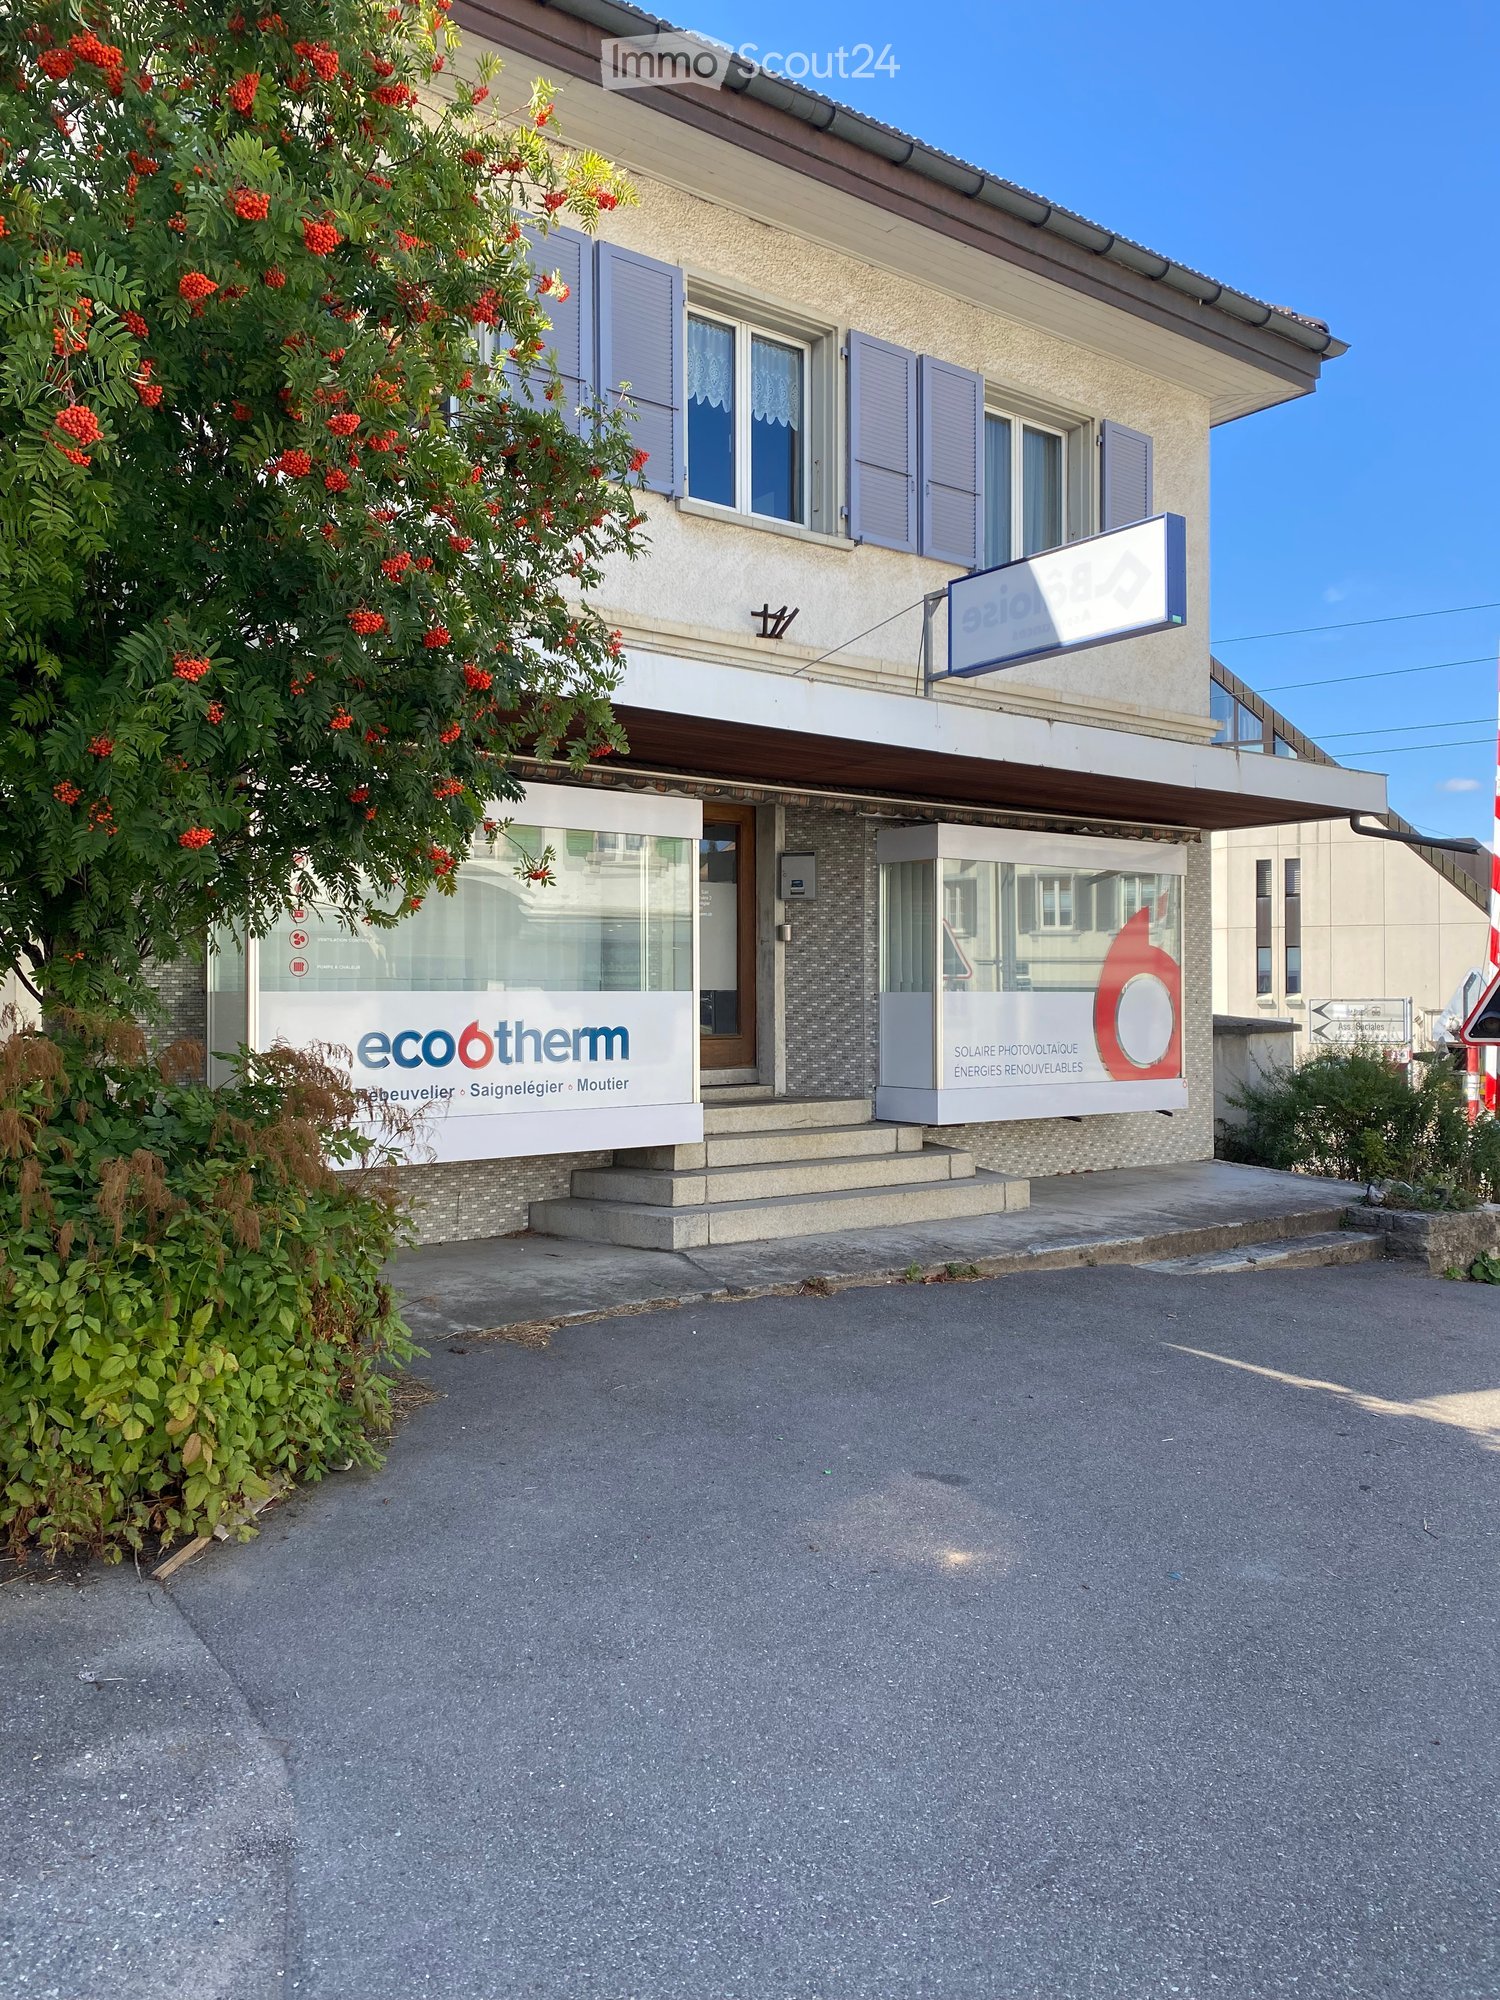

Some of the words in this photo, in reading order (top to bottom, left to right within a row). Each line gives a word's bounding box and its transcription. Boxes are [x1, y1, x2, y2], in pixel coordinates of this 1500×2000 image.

[954, 1045, 996, 1058] SOLAIRE
[998, 1041, 1079, 1056] PHOTOVOLTAÏQUE
[954, 1063, 1002, 1078] ÉNERGIES
[1004, 1061, 1084, 1076] RENOUVELABLES
[470, 1081, 564, 1100] Saignelégier
[577, 1077, 630, 1092] Moutier
